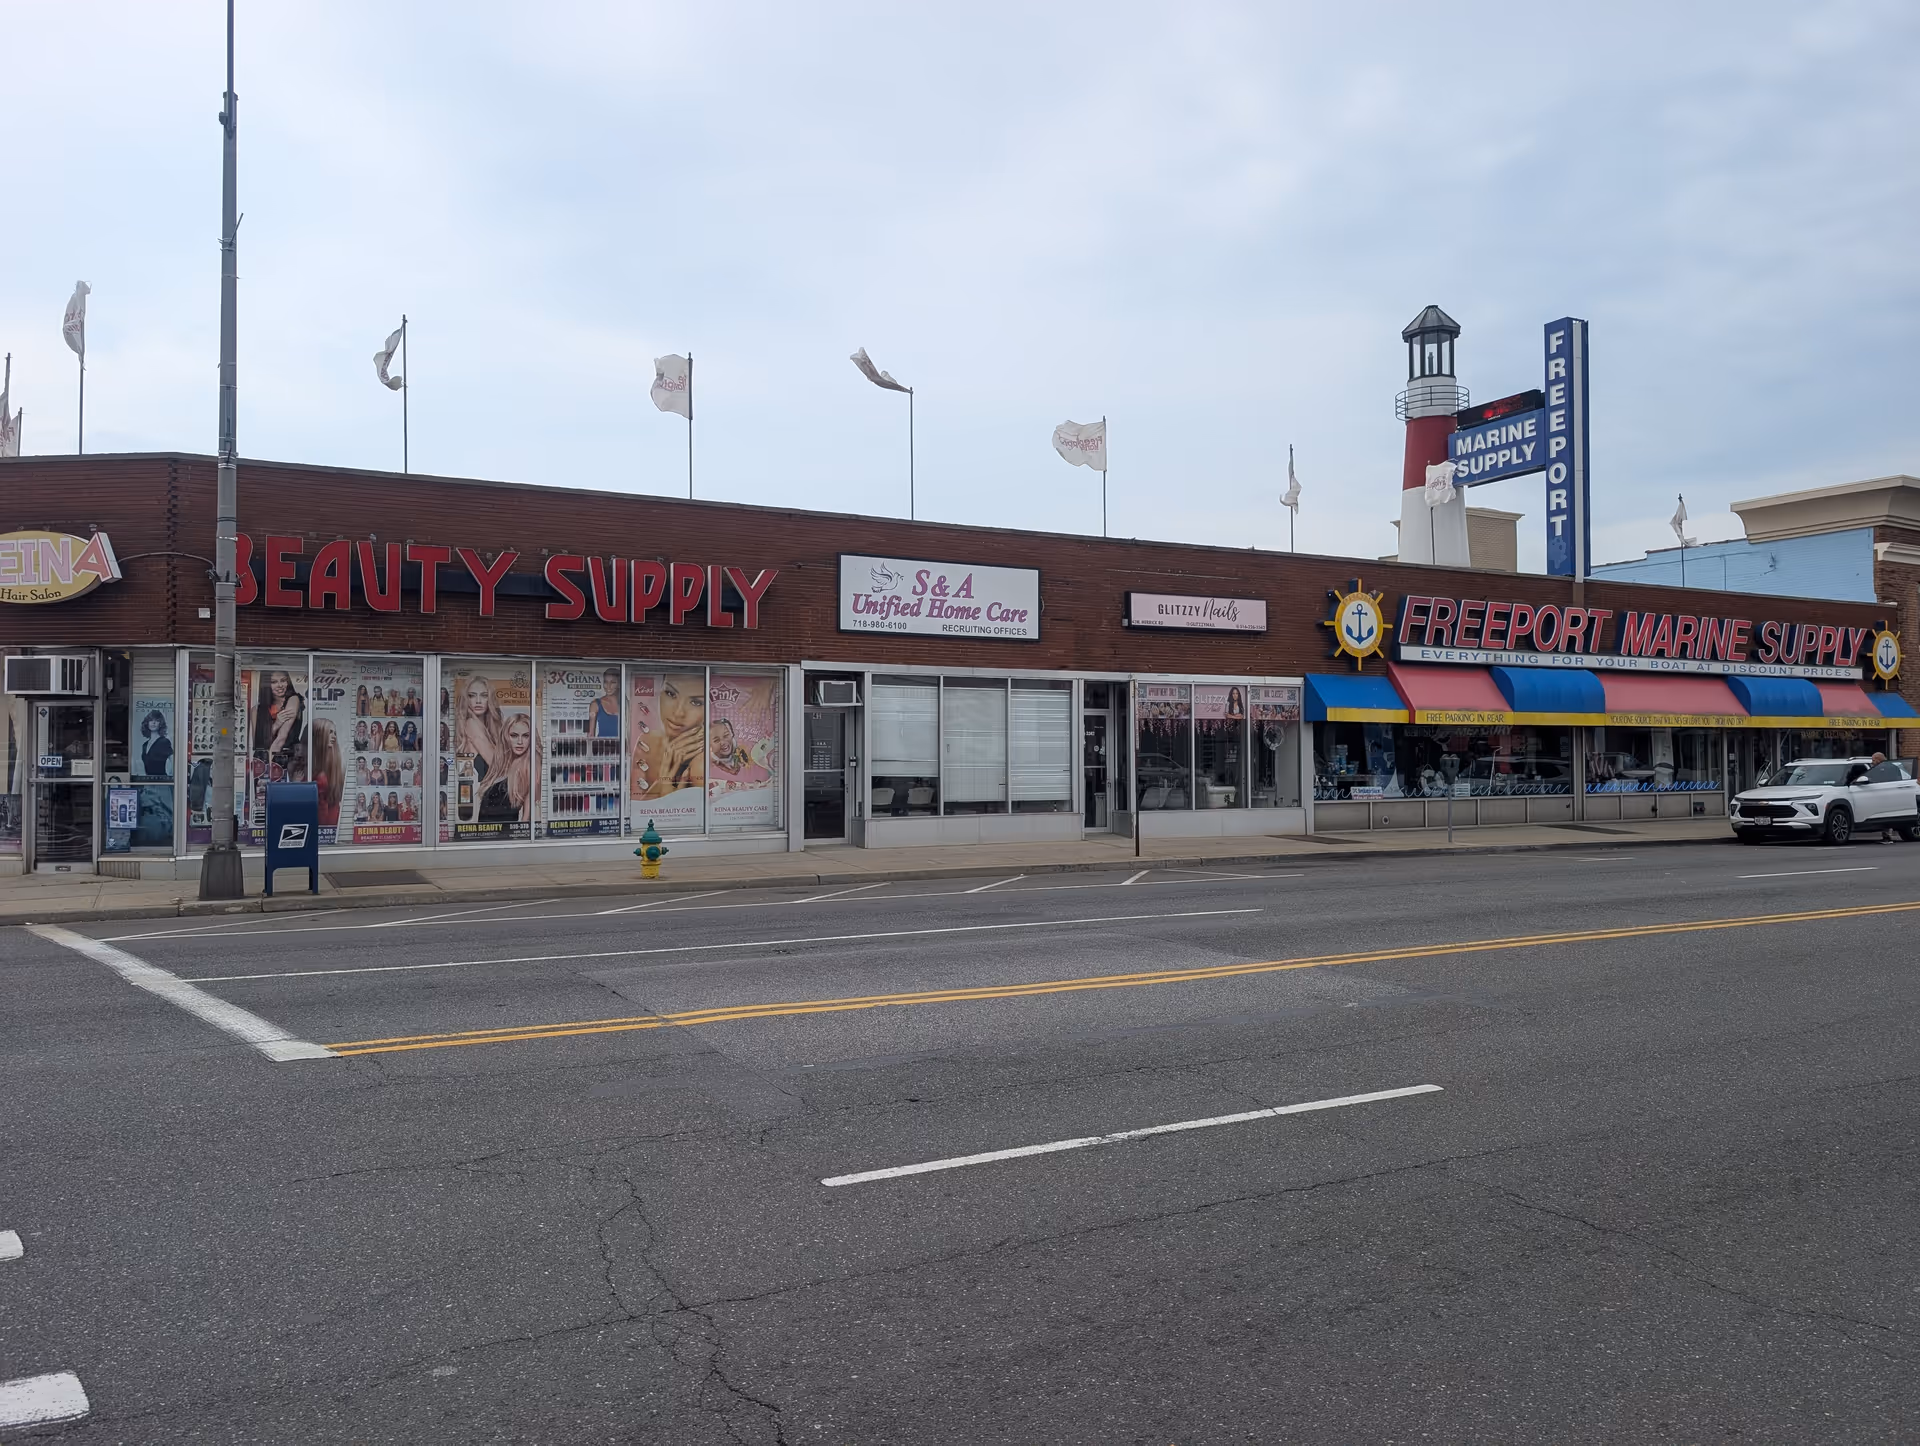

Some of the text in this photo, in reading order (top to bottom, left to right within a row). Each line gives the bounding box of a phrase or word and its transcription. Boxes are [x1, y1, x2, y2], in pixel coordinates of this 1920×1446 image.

[1455, 417, 1537, 457] MARINE
[1548, 329, 1568, 538] FREEPORT
[1456, 440, 1537, 479] SUPPLY
[235, 532, 779, 629] BEAUTY SUPPLY
[912, 569, 975, 599] S & A
[1, 587, 62, 601] Hair Salon
[853, 593, 1028, 623] Unified Home Care
[1158, 598, 1241, 622] GLITZZY Nails
[853, 619, 1027, 636] 718-980-6100 RECRUITING OFFICES
[1399, 595, 1867, 666] FREEPORT MARINE SUPPLY
[360, 665, 393, 676] Destiny
[1421, 649, 1851, 677] EVERYTHING FOR YOUR BOAT AT DISCOUNT PRICES
[548, 670, 566, 685] 3X
[496, 690, 517, 699] Gold
[710, 688, 738, 702] Pink
[1426, 713, 1504, 724] FREE PARKING IN REAR
[1610, 716, 1623, 724] YOUR
[1634, 716, 1652, 725] SOURCE
[41, 757, 61, 766] OPEN
[569, 820, 593, 828] BEAUTY
